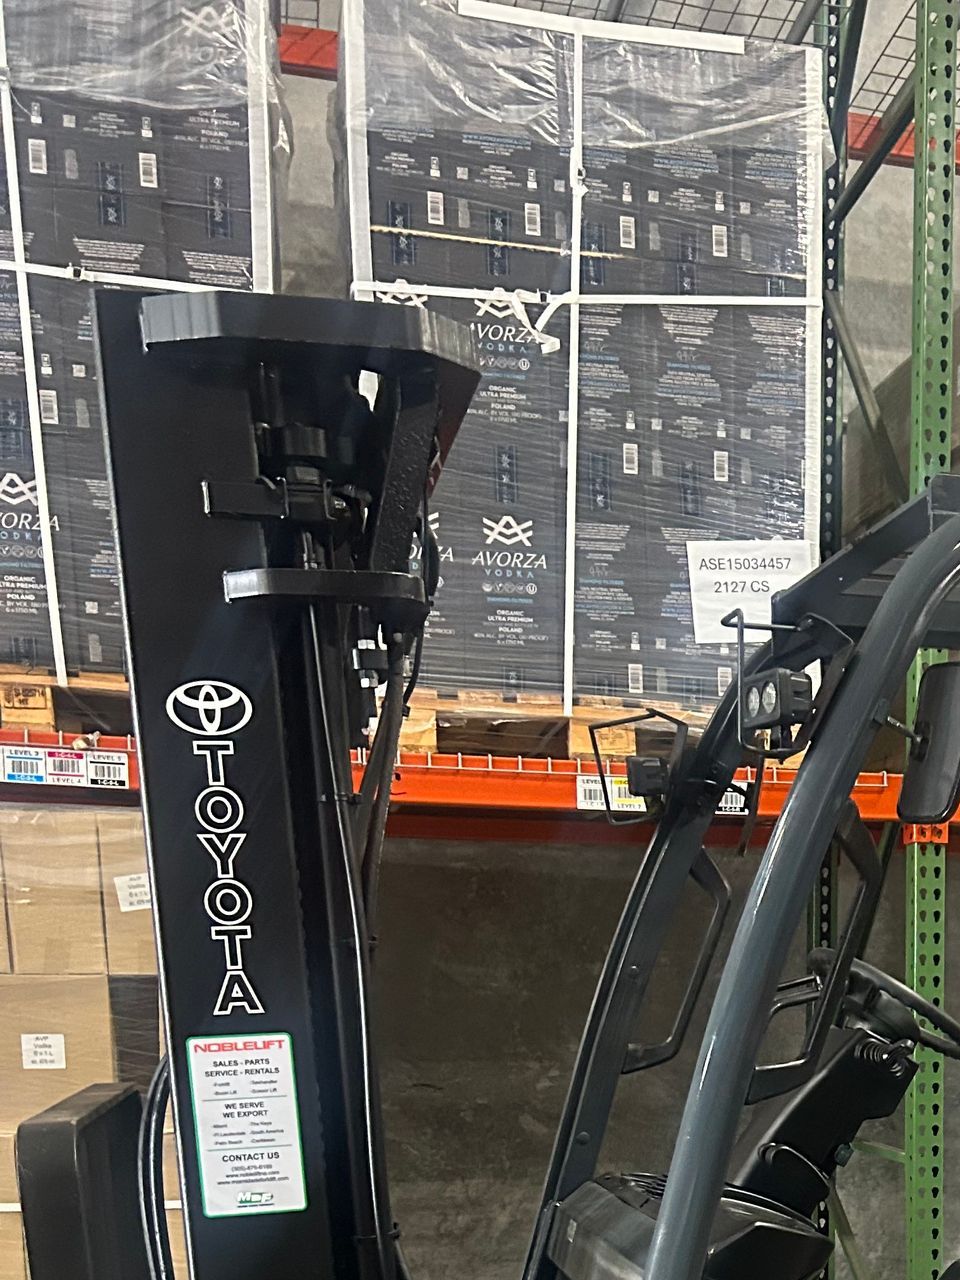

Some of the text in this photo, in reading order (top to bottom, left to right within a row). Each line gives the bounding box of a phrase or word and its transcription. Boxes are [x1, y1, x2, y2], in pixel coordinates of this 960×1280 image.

[499, 392, 526, 400] PREMIUM
[471, 551, 547, 570] AVORZA
[699, 556, 792, 572] ASE15034457
[484, 568, 534, 579] VODKA
[714, 581, 770, 594] 2127 CS
[497, 609, 525, 617] ORGANIC
[192, 740, 265, 1016] TOYOTA
[194, 1039, 285, 1053] NOBLELIFT
[213, 1059, 239, 1067] SALES
[244, 1057, 270, 1066] PARTS
[204, 1069, 238, 1078] SERVICE
[244, 1067, 280, 1075] RENTALS
[239, 1101, 265, 1109] SERVE
[237, 1110, 268, 1118] EXPORT
[222, 1151, 280, 1163] CONTACT US
